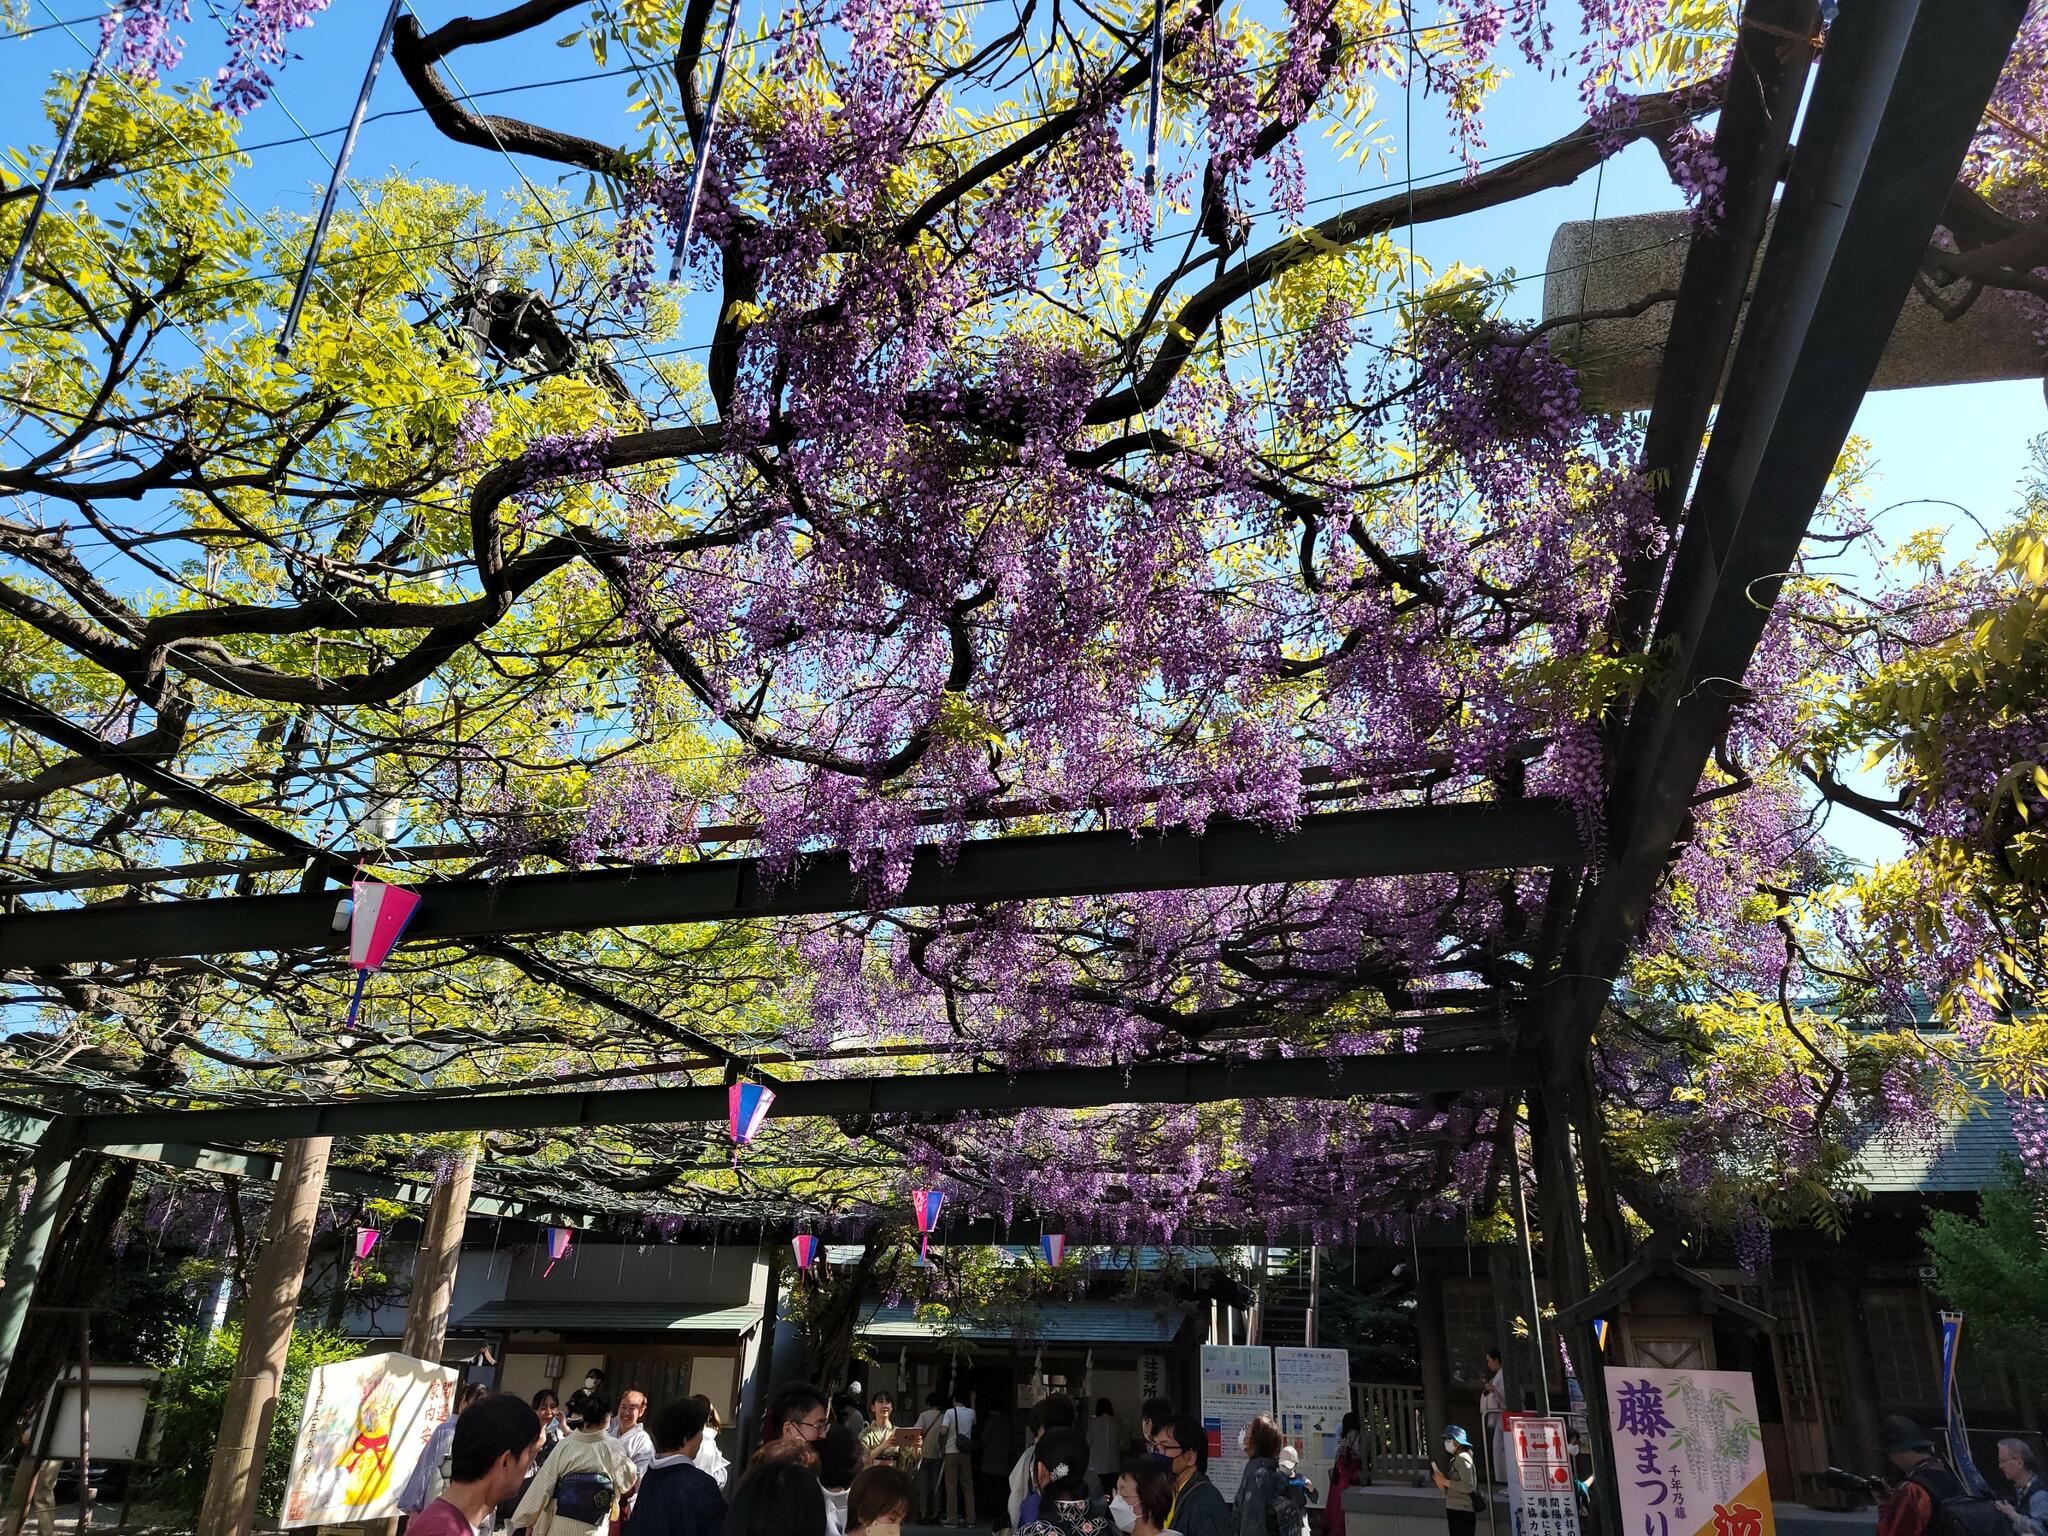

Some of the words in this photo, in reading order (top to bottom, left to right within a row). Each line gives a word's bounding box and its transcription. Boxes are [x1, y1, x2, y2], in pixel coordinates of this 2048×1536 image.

[1143, 1356, 1158, 1398] 社務所
[1616, 1379, 1676, 1536] 藤まつり
[1668, 1464, 1687, 1520] 千年乃藤
